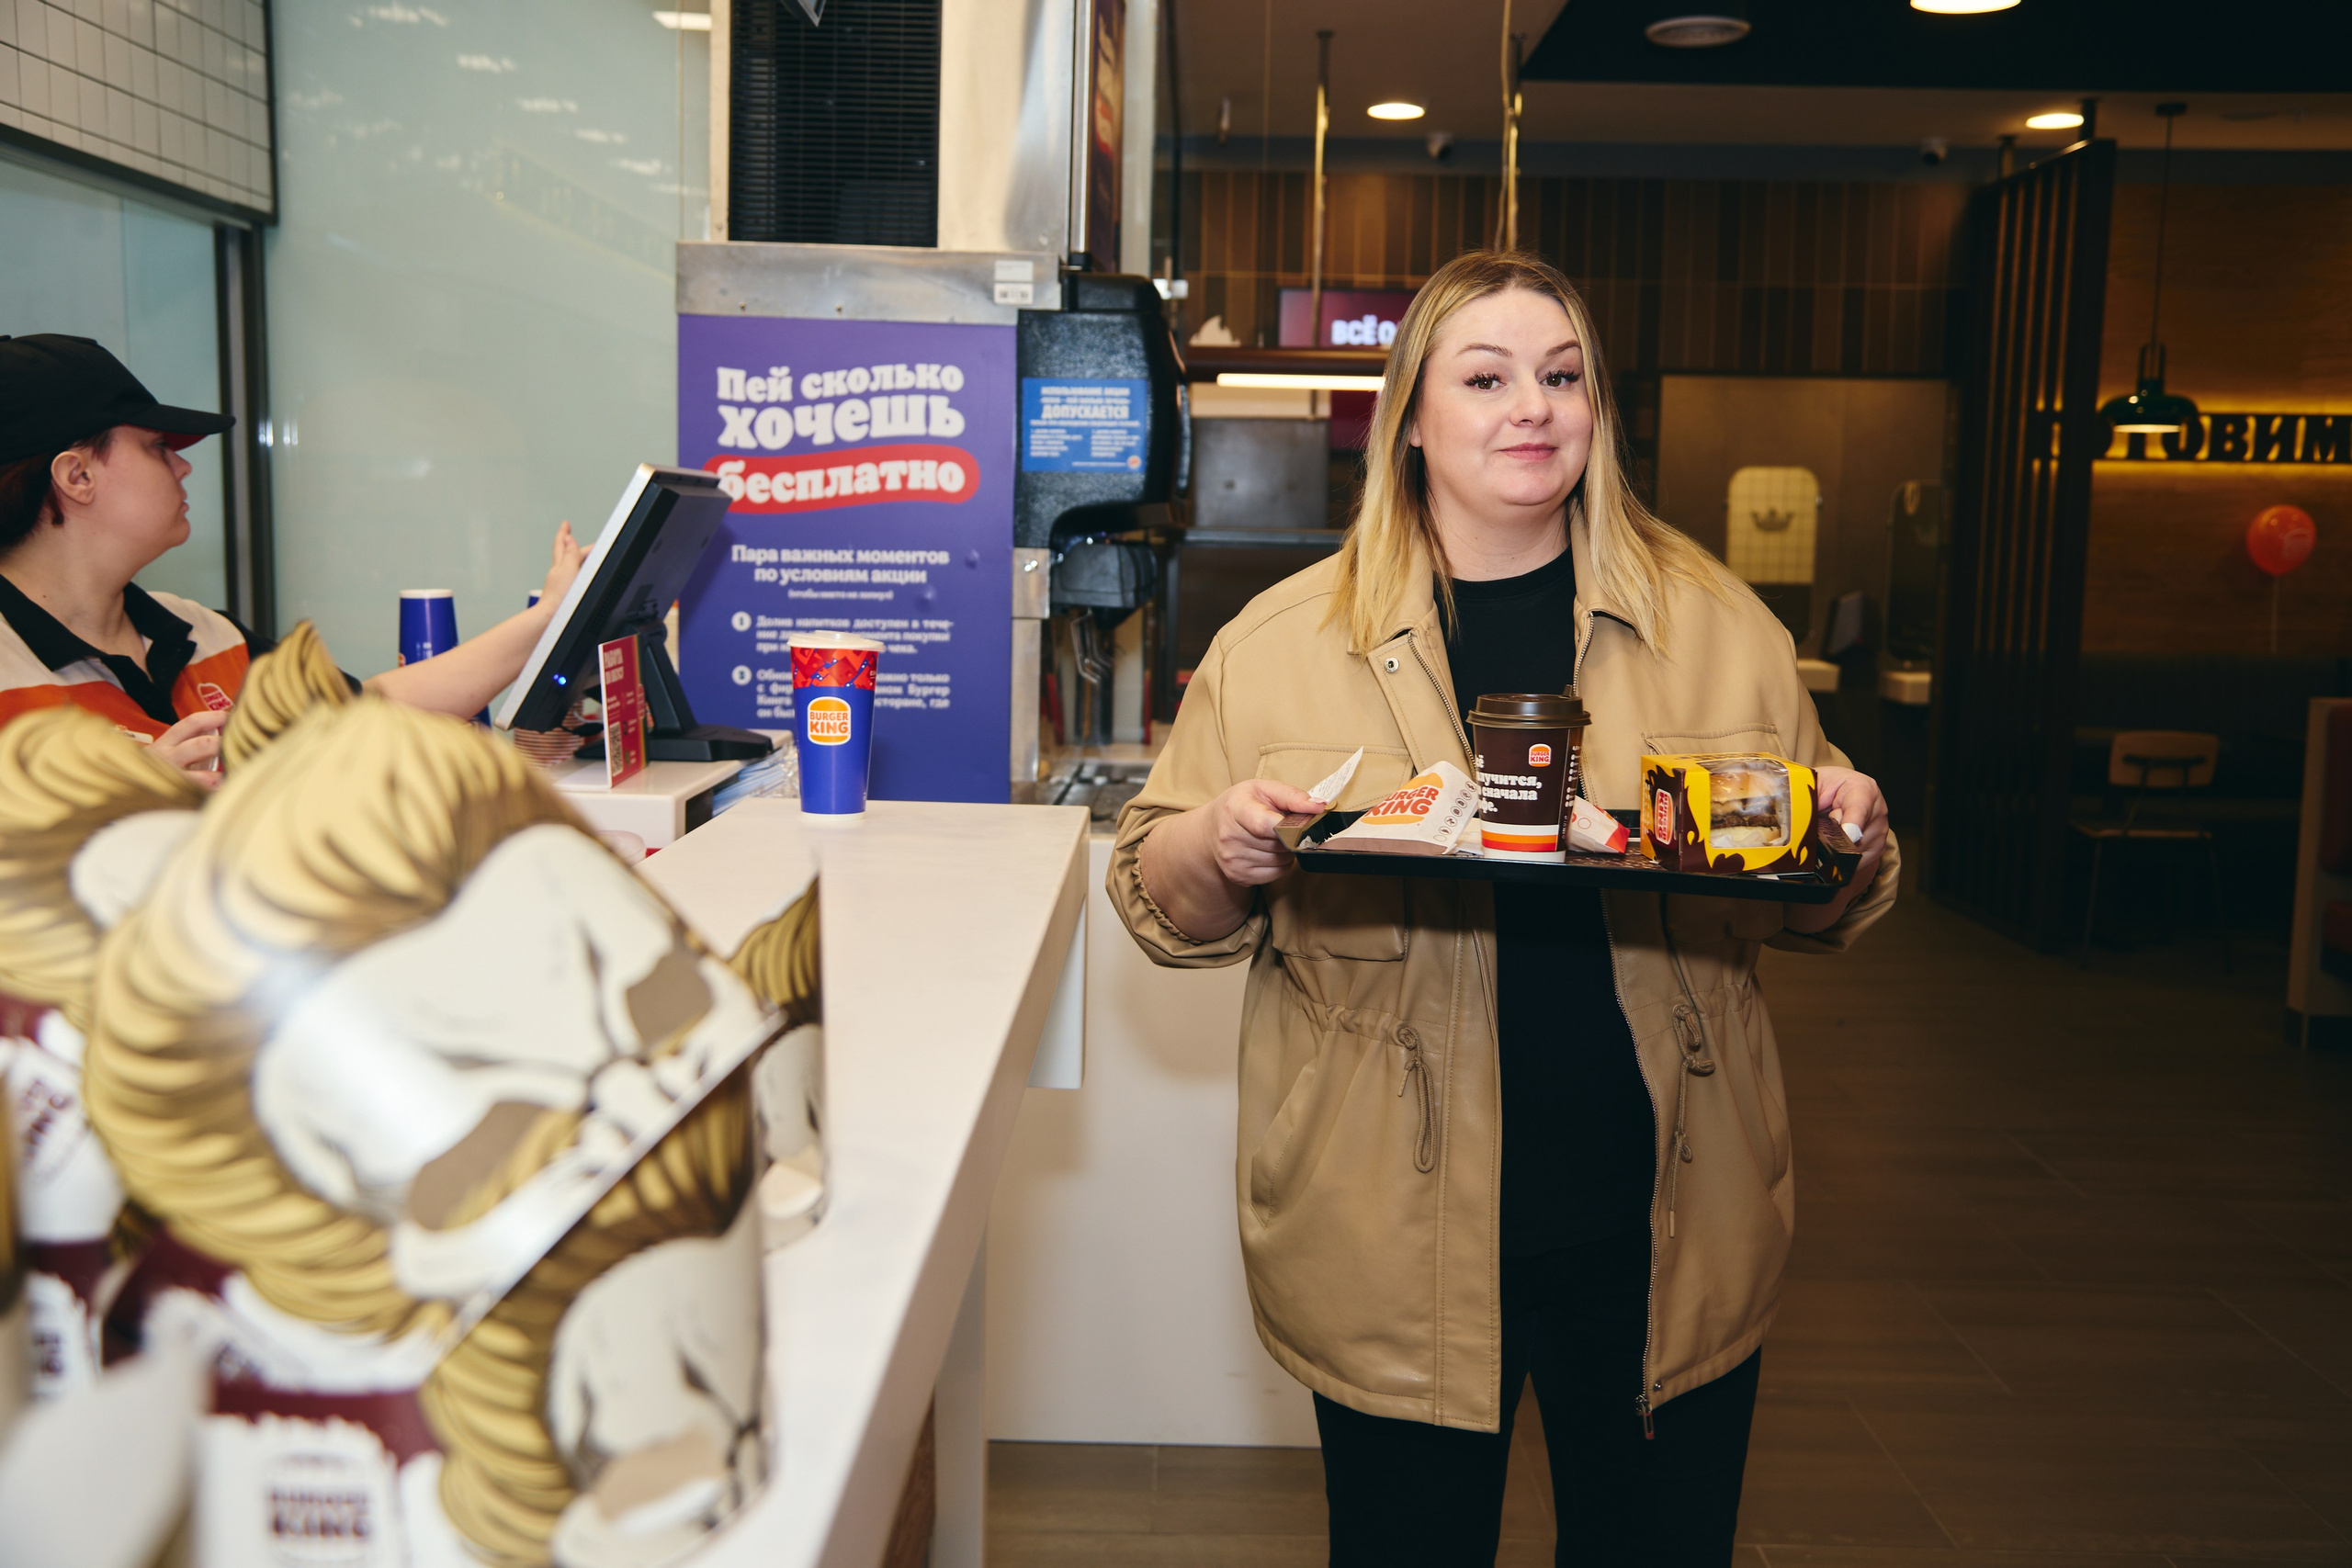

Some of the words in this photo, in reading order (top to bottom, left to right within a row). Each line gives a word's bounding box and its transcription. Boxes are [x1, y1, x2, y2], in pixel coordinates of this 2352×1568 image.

[1331, 314, 1378, 346] ВСЁ
[717, 367, 793, 404] Пей
[800, 363, 965, 400] сколько
[1041, 404, 1129, 420] ДОПУСКАЕТСЯ
[718, 394, 967, 451] хочешь
[717, 459, 967, 504] бесплатно
[731, 544, 779, 567] Пара
[780, 548, 854, 564] важных
[855, 549, 951, 565] моментов
[754, 568, 778, 582] по
[779, 568, 869, 586] условиям
[870, 570, 927, 585] акции
[809, 712, 849, 721] BURGER
[809, 721, 849, 734] KING
[1476, 772, 1543, 789] лучится,
[1385, 786, 1440, 802] URGER
[1482, 786, 1539, 801] сначала
